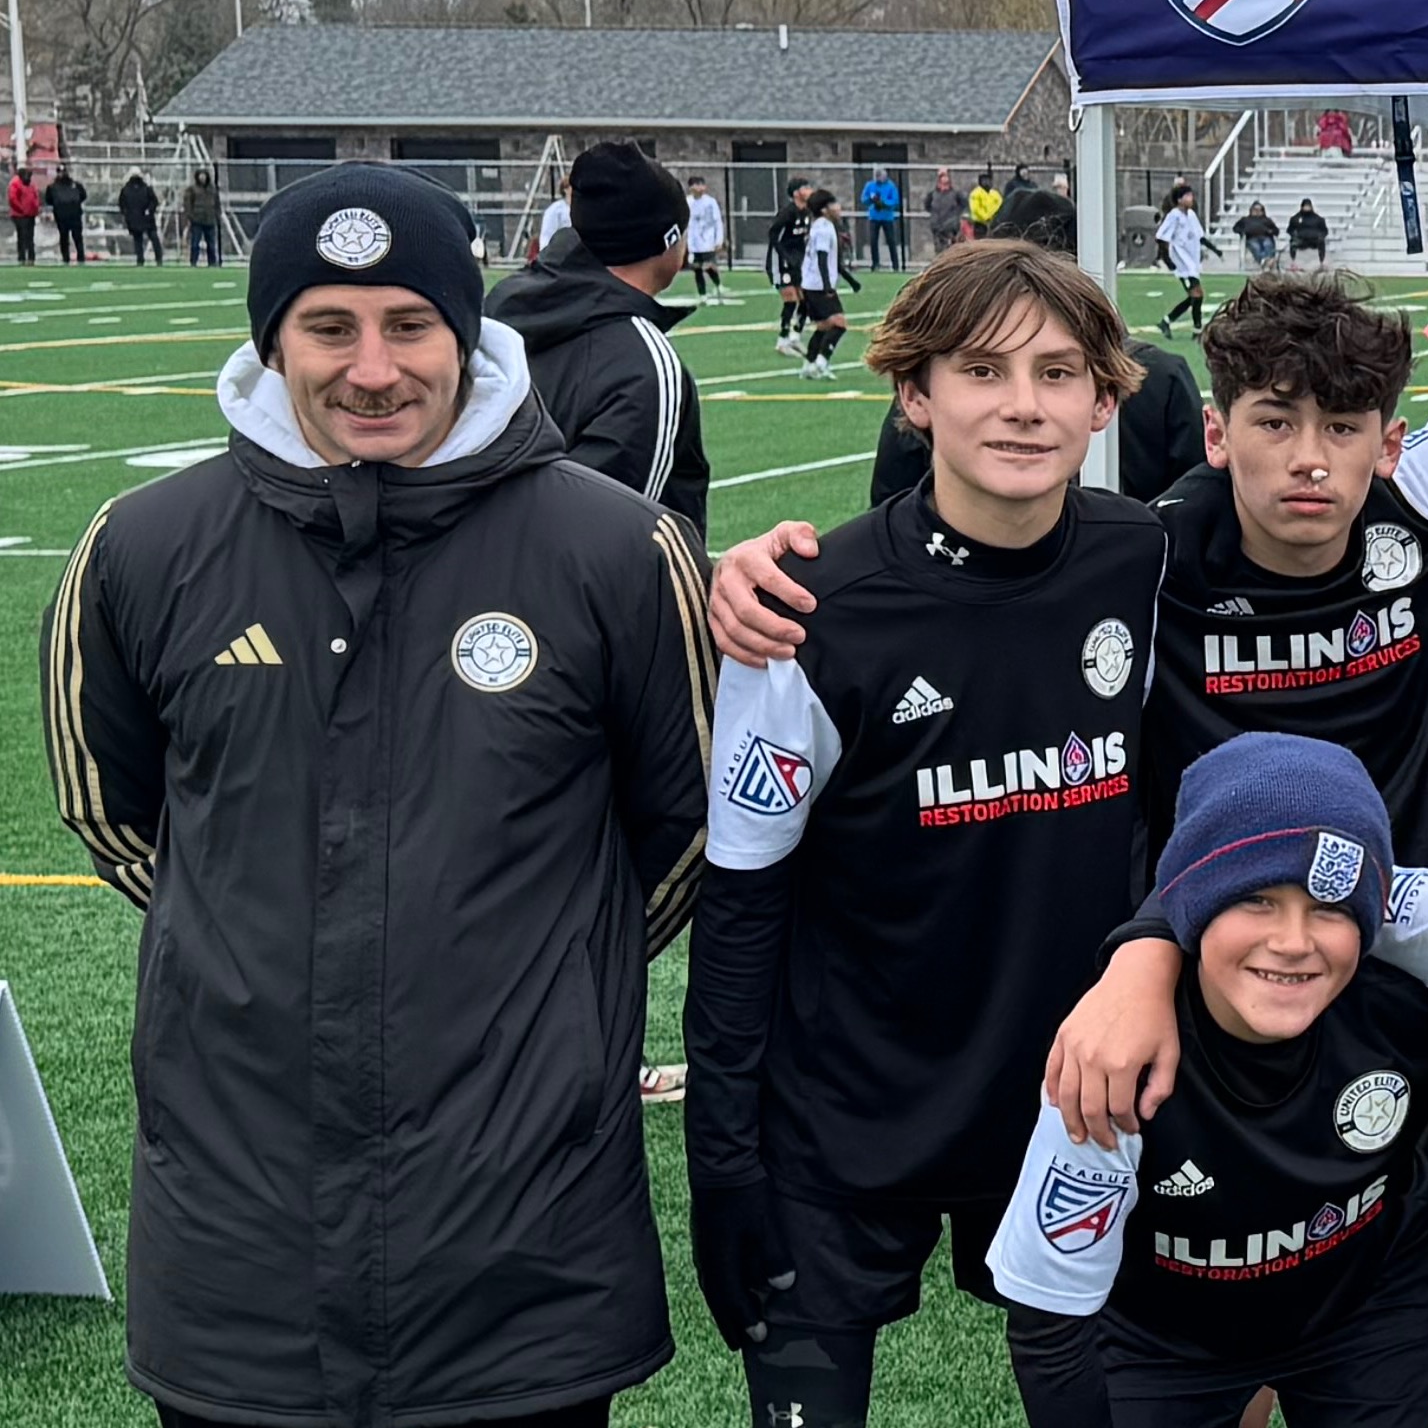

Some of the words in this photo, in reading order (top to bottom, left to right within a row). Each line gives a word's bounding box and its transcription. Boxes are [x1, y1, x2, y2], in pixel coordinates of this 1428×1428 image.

[1205, 665, 1342, 695] RESTORATION
[892, 696, 955, 725] adidas
[919, 791, 1059, 827] RESTORATION
[1061, 774, 1130, 808] SERVICES
[1339, 1078, 1371, 1117] UNITED
[1373, 1076, 1401, 1089] ELITE
[1052, 1155, 1131, 1185] LEAGUE
[1153, 1175, 1215, 1197] adidas
